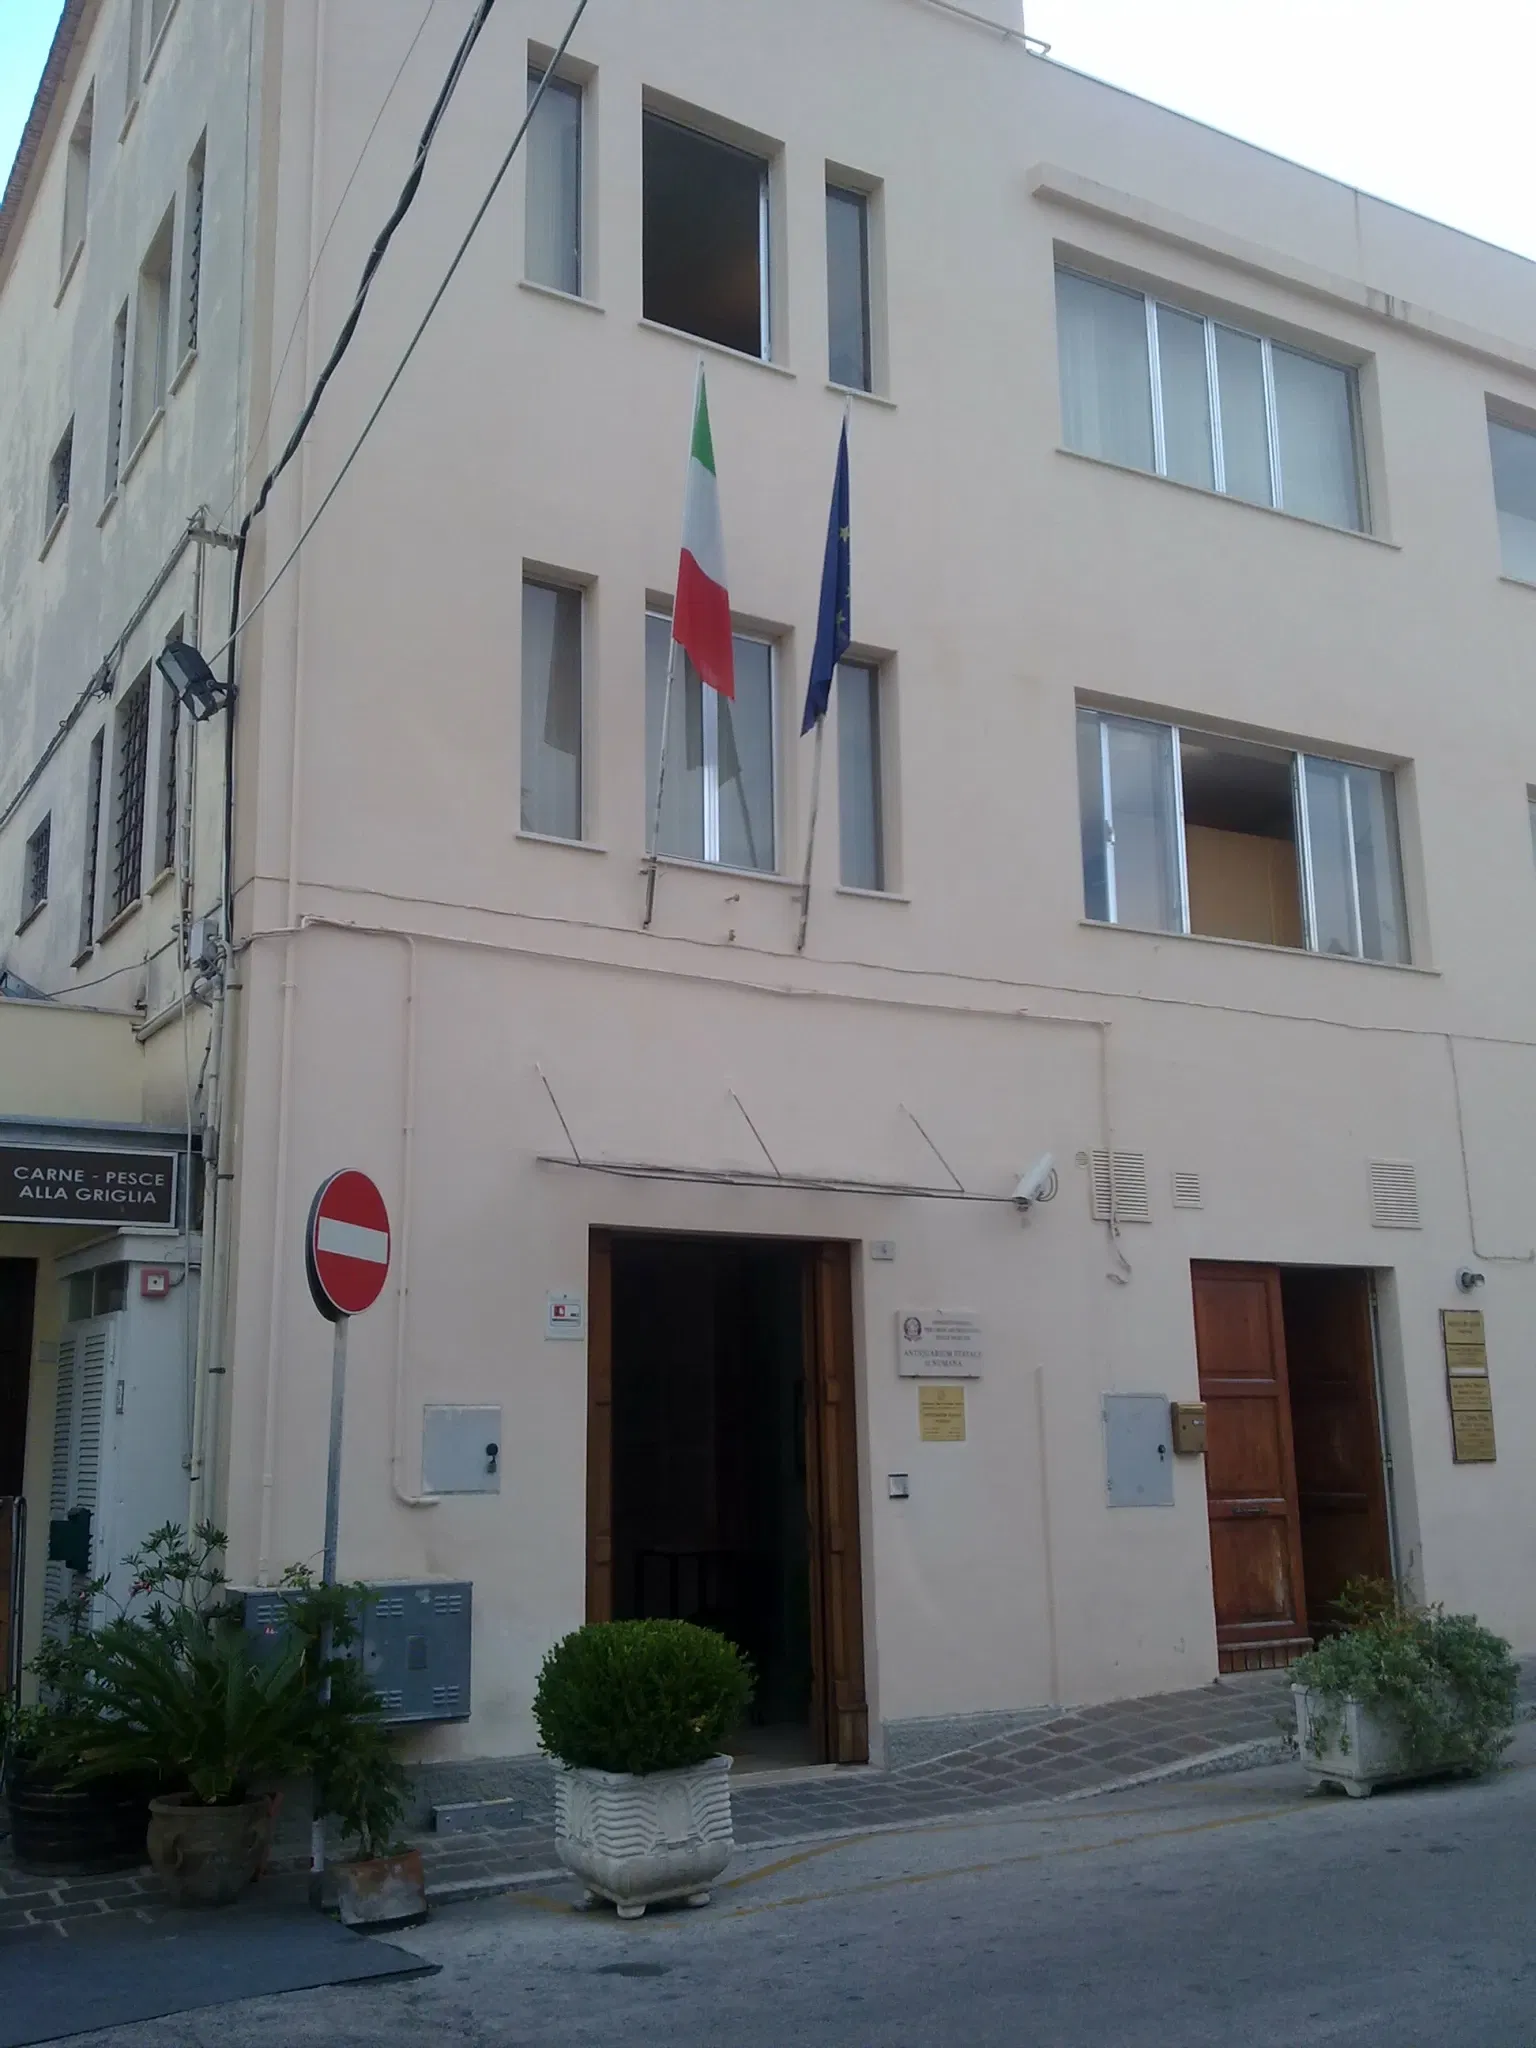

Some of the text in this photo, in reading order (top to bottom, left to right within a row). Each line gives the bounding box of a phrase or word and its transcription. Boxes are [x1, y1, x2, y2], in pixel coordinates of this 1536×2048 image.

[14, 1166, 84, 1182] CARNE
[106, 1171, 165, 1186] PESCE
[19, 1185, 157, 1204] ALLA GRIGLIA
